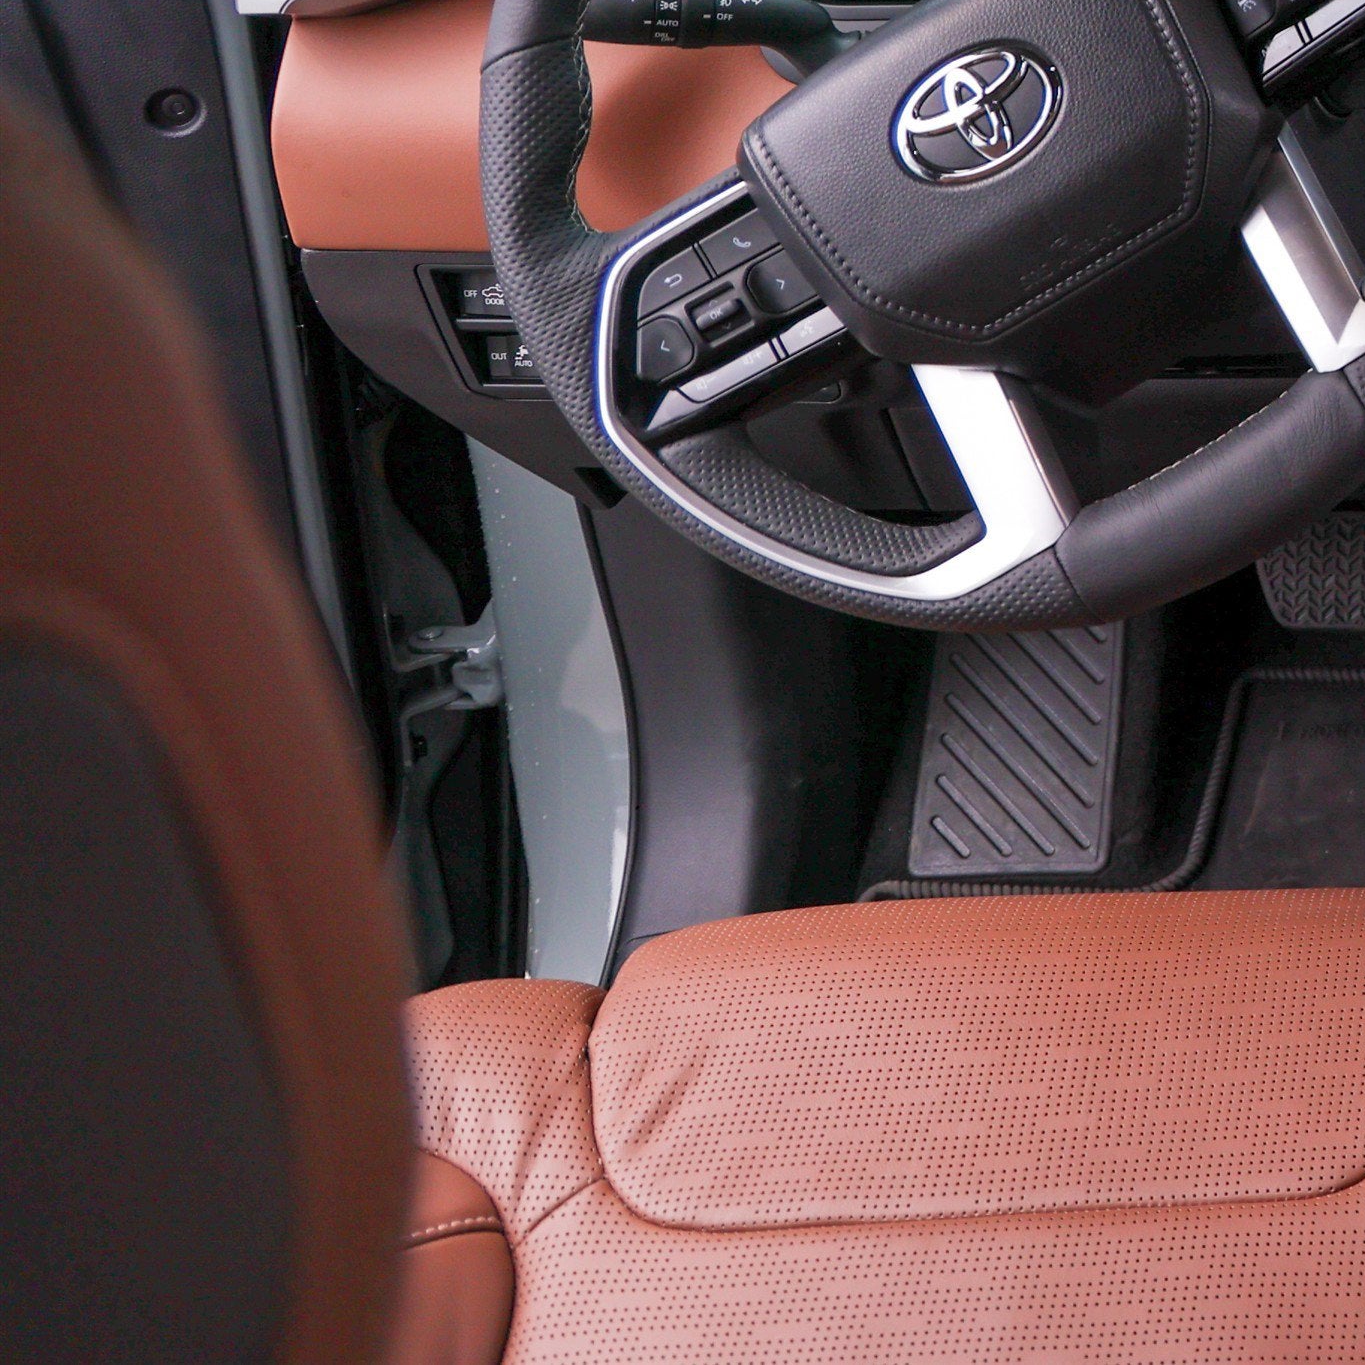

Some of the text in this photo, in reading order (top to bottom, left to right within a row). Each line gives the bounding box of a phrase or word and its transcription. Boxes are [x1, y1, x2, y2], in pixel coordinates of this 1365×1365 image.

[716, 13, 733, 21] OFF
[656, 19, 679, 27] AUTO
[463, 289, 478, 298] OFF
[709, 308, 724, 321] OK
[491, 352, 507, 360] OUT
